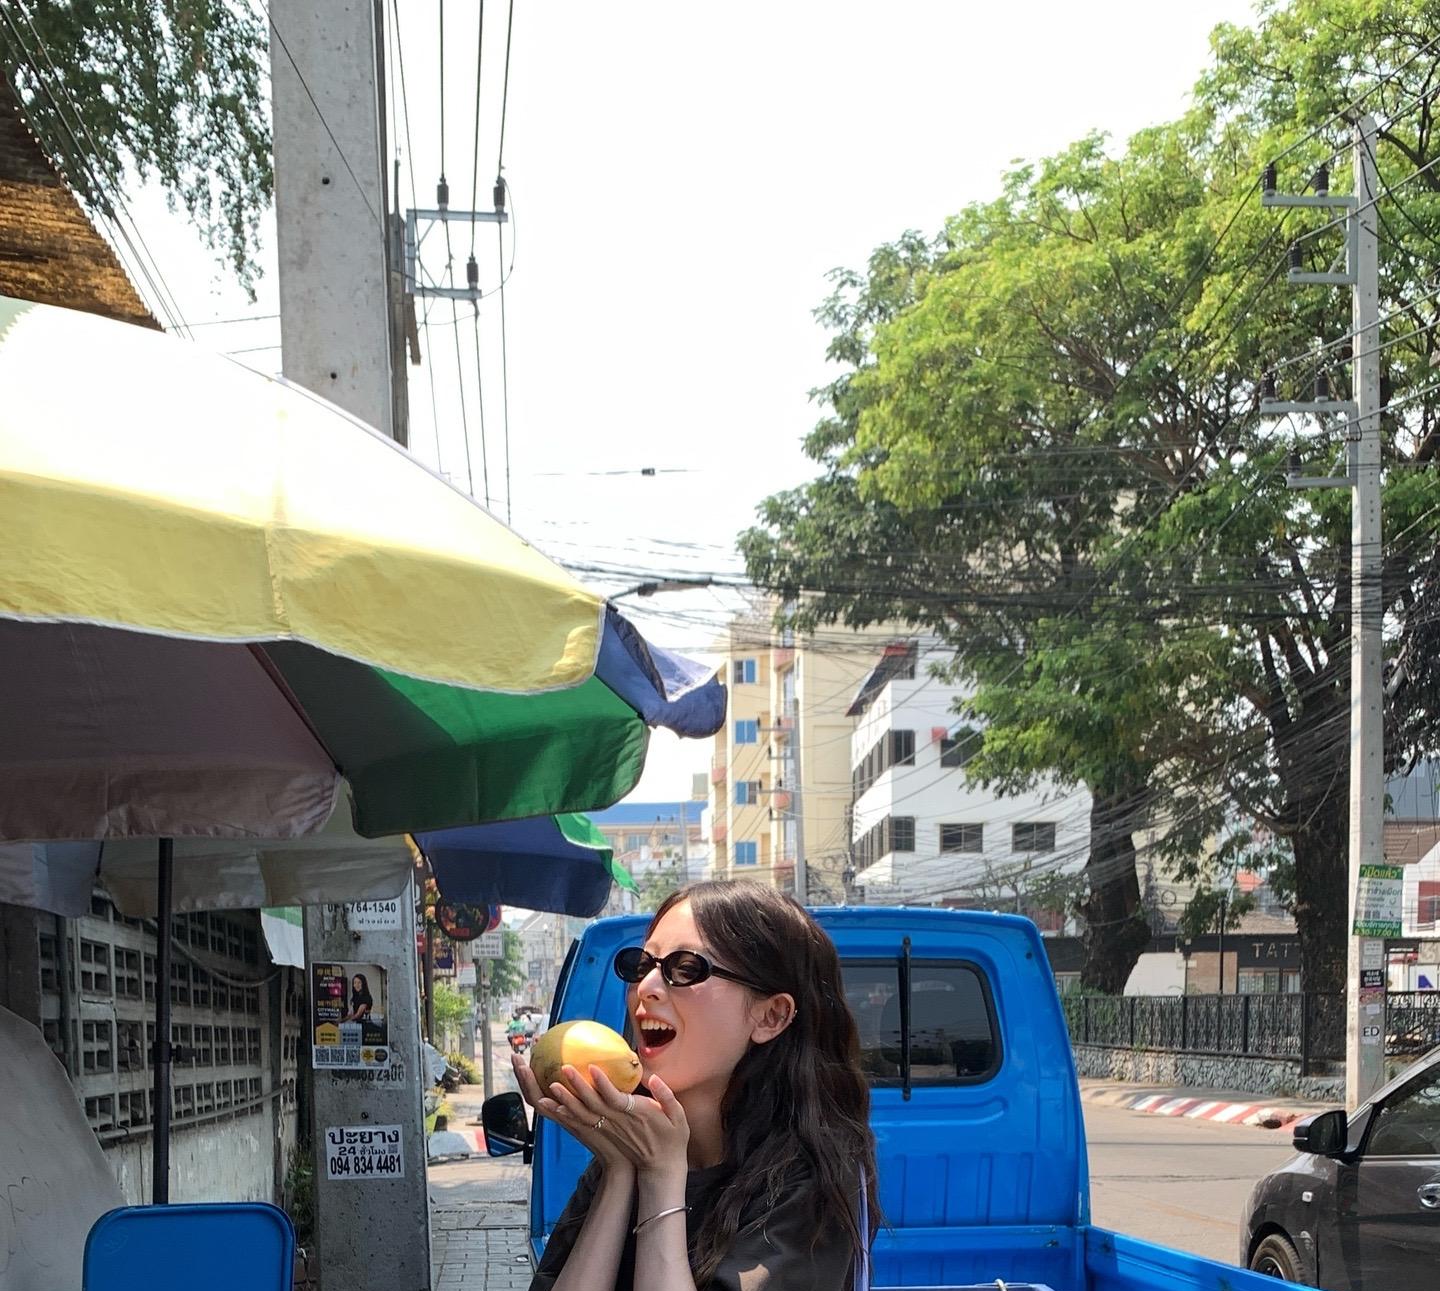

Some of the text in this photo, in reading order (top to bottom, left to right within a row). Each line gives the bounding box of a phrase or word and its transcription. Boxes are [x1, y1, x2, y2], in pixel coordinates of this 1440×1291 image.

[328, 1128, 400, 1145] ปะยาง
[338, 1146, 357, 1156] 24
[330, 1154, 402, 1175] 094 834 4481
